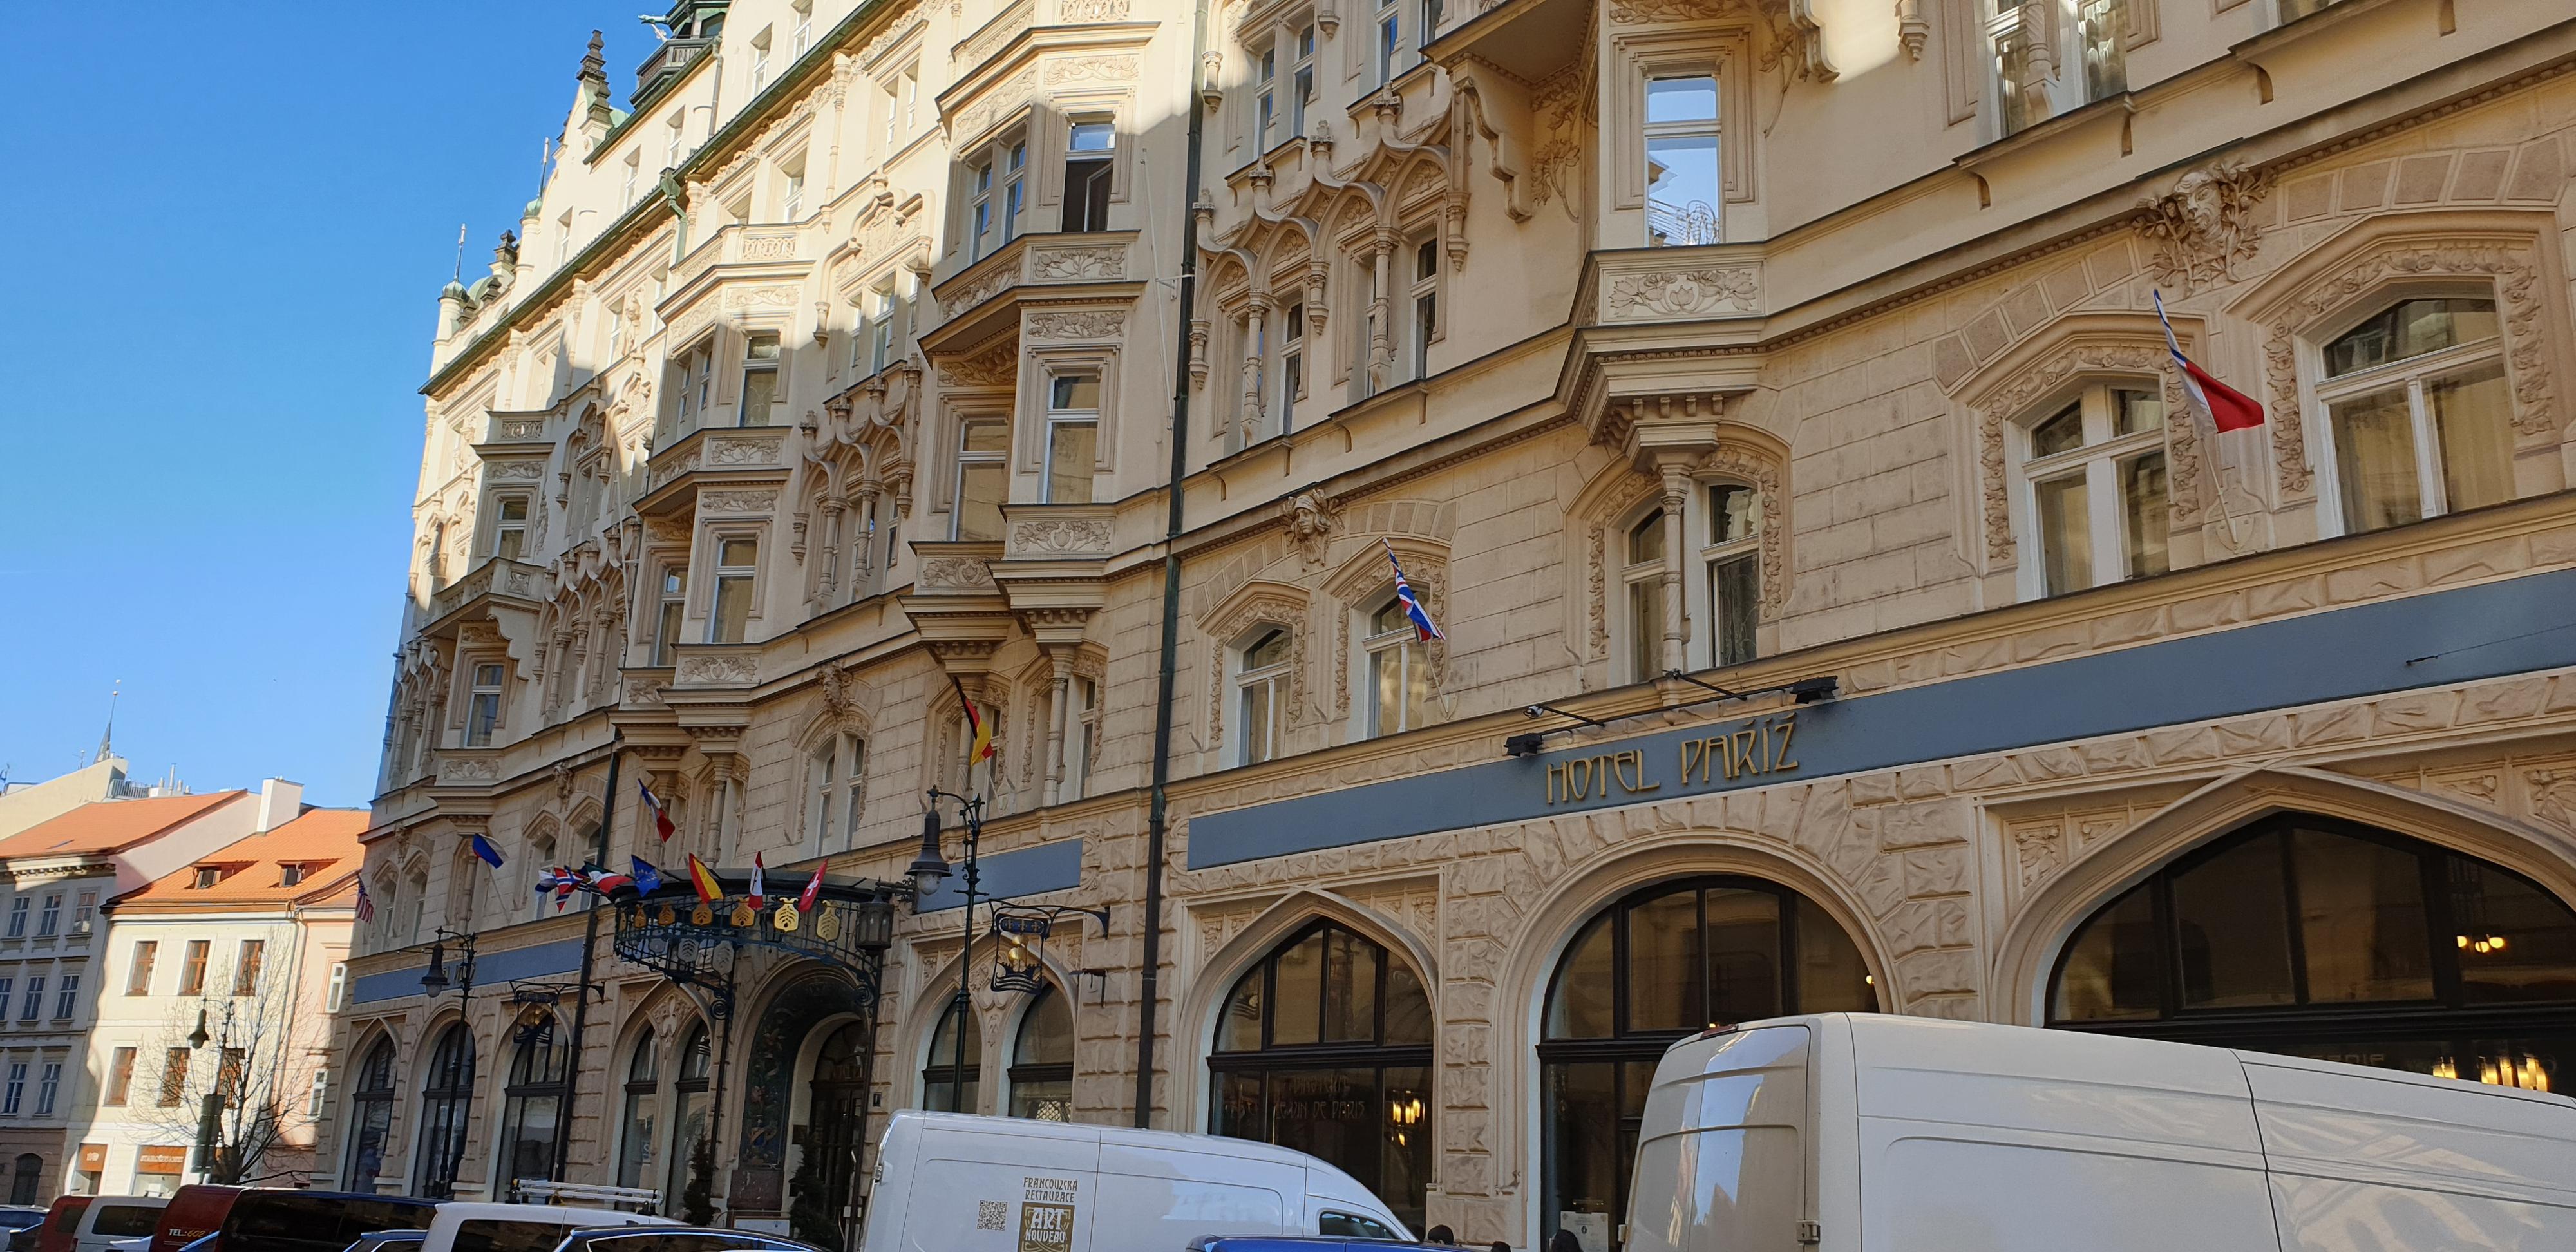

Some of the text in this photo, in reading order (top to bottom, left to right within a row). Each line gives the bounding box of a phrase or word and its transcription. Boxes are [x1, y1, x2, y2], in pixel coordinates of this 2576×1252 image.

[1547, 749, 1660, 804] HOTEL
[1332, 1101, 1365, 1119] PARIS
[1025, 1190, 1074, 1202] RESTAURACE
[1031, 1208, 1064, 1229] ART
[1025, 1230, 1065, 1243] NOUVEAU
